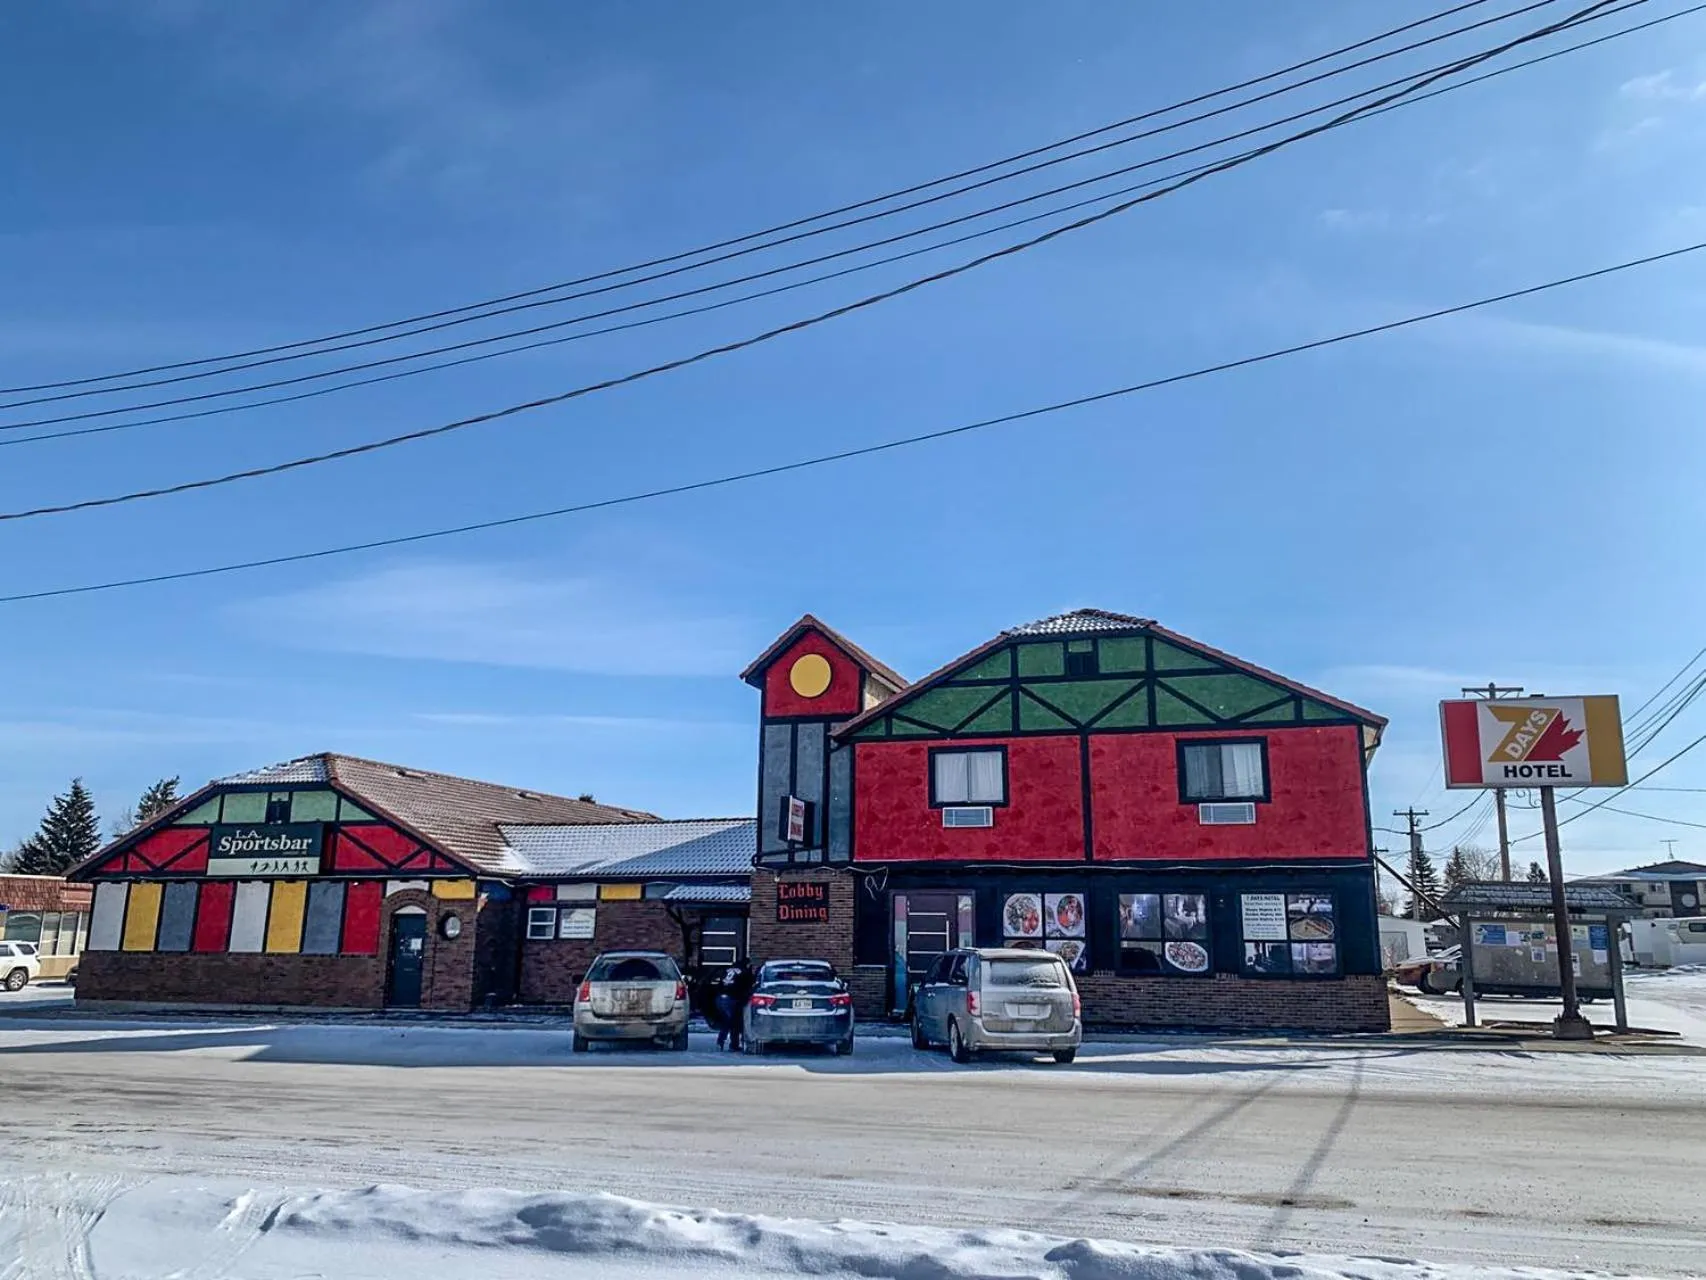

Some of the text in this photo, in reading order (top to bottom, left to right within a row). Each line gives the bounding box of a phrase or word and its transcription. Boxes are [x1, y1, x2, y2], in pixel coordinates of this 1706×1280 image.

[1487, 706, 1560, 762] 7 DAYS
[1504, 765, 1572, 778] HOTEL
[218, 834, 312, 855] Sportsbar
[778, 883, 823, 900] Lobby
[779, 905, 827, 921] Dining
